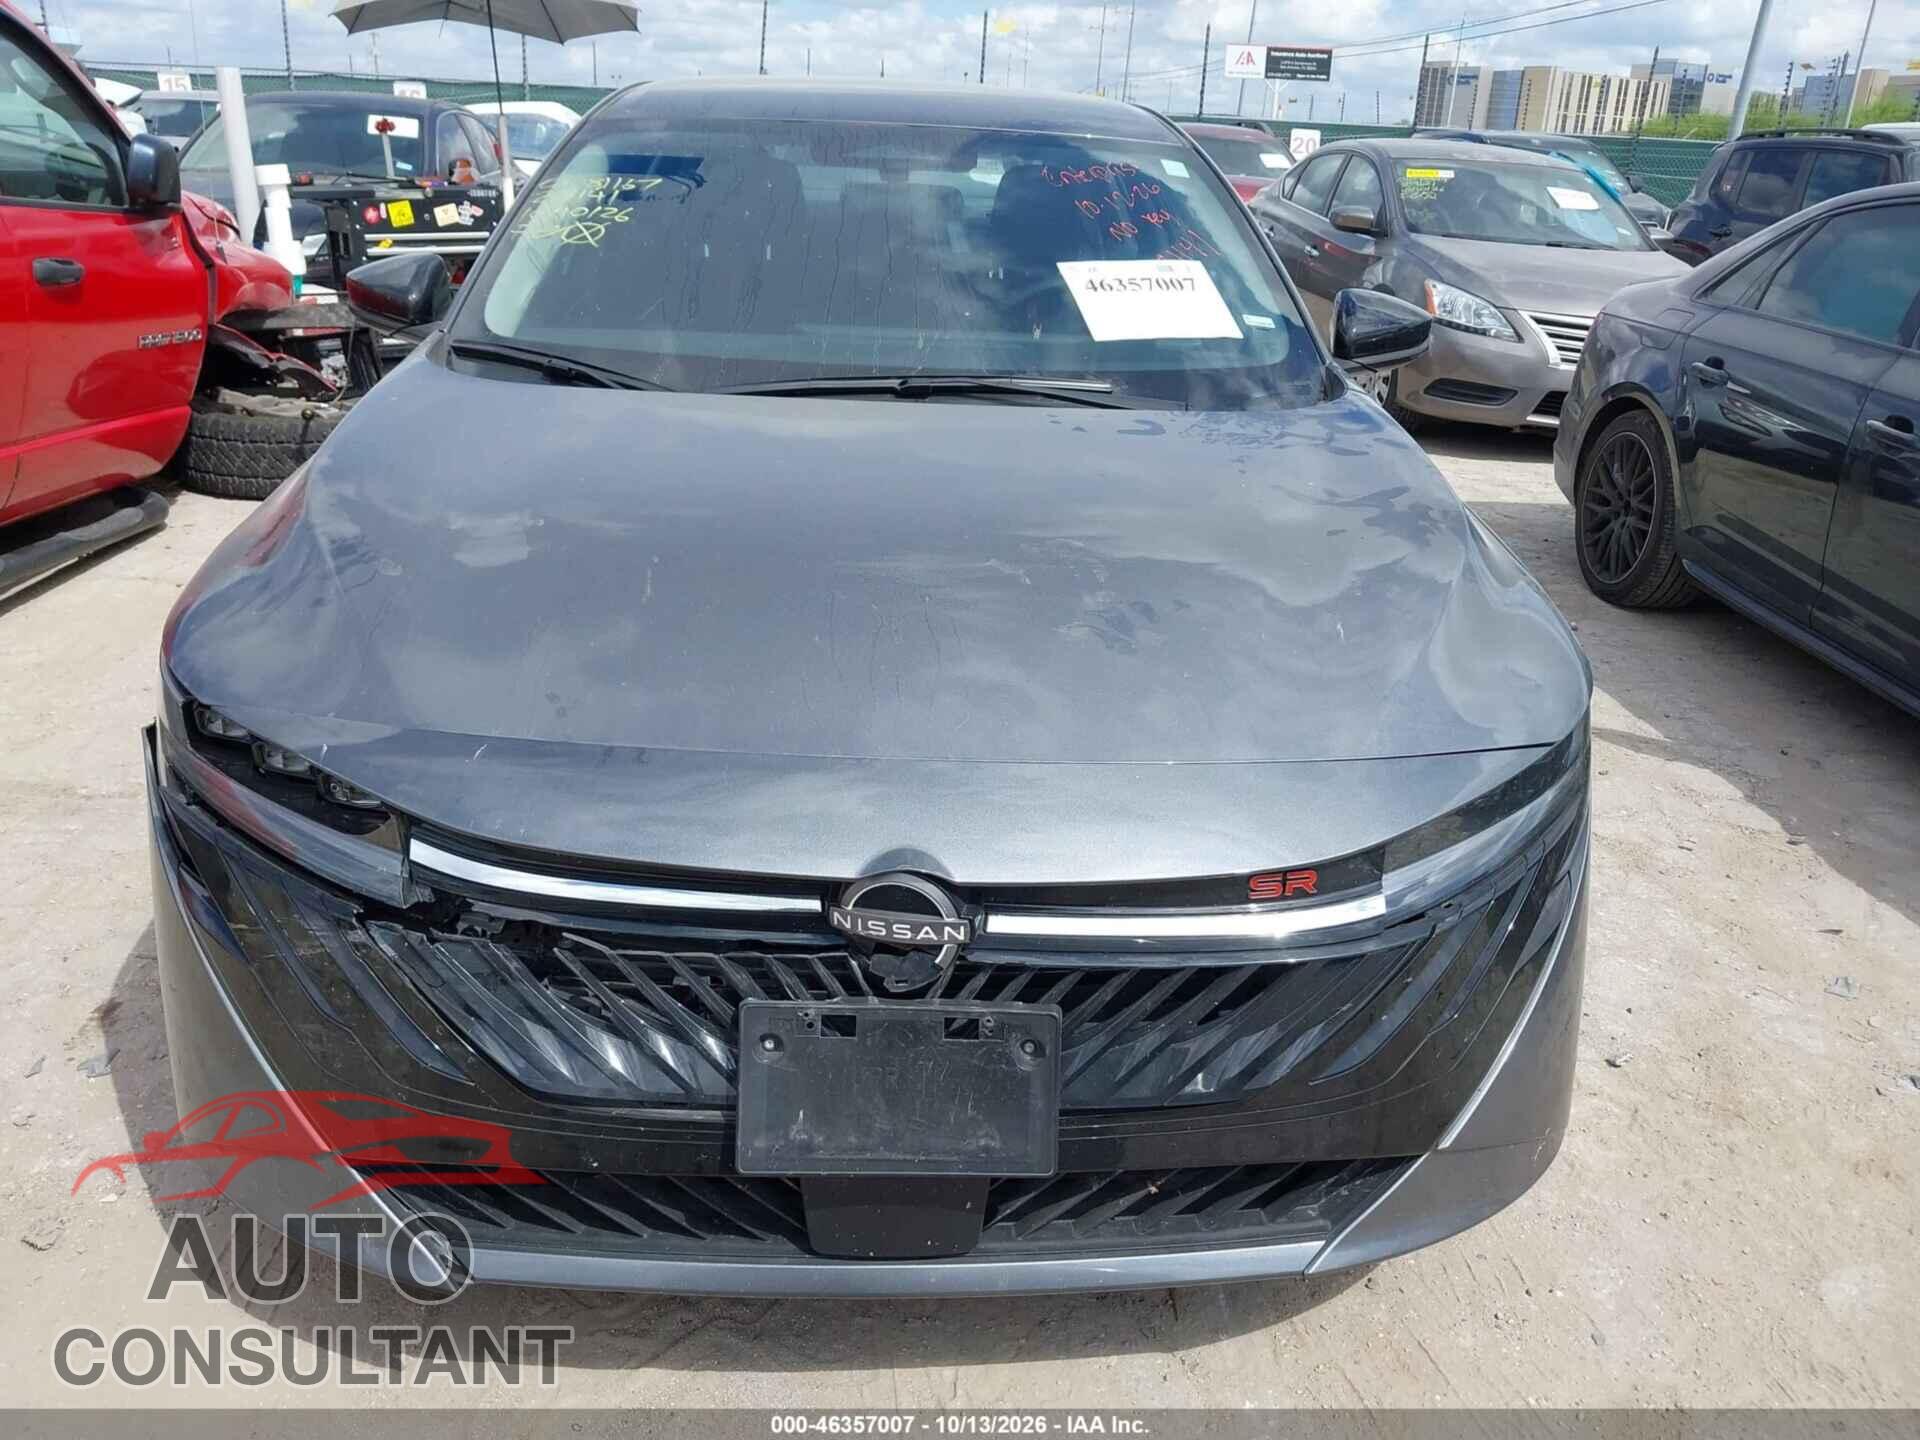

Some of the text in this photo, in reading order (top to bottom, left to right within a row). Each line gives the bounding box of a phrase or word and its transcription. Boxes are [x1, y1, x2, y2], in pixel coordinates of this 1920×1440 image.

[1291, 136, 1318, 155] 20
[1085, 276, 1196, 293] 46357007
[1248, 869, 1319, 900] SR
[832, 910, 966, 941] NISSAN
